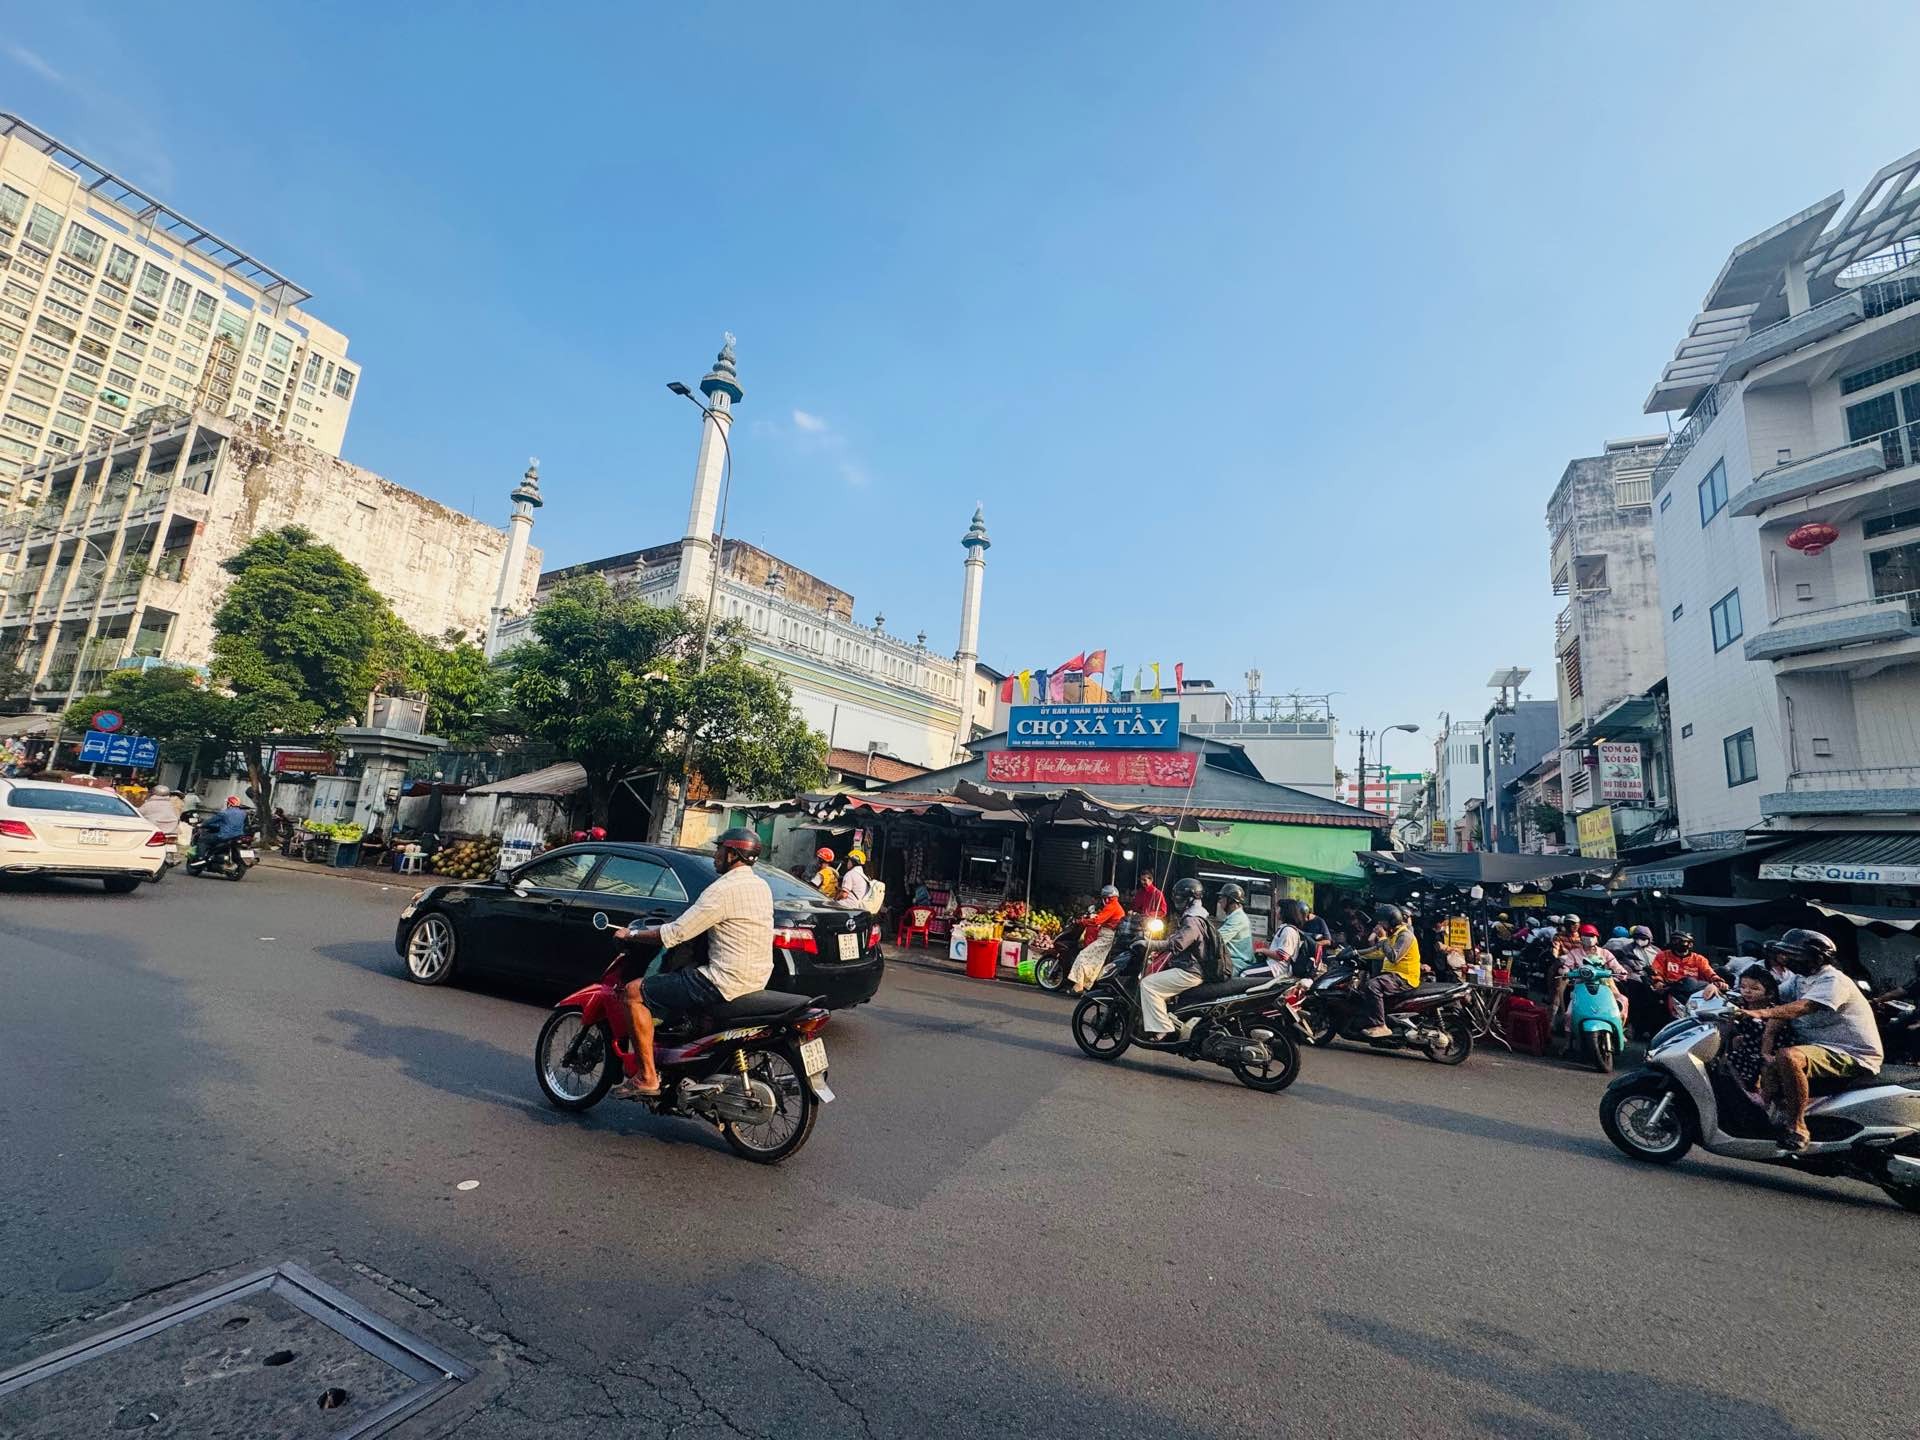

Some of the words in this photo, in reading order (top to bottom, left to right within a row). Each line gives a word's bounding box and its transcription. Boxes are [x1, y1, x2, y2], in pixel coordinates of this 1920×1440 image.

[1040, 706, 1050, 715] ỦY
[1069, 706, 1091, 714] NHÂN
[1111, 707, 1133, 716] QUẬN
[1135, 706, 1142, 714] 5
[1016, 718, 1069, 740] CHỢ
[1072, 715, 1108, 735] XÃ
[1114, 713, 1168, 735] TÂY
[1624, 743, 1638, 753] GÀ
[1826, 867, 1880, 881] Quán
